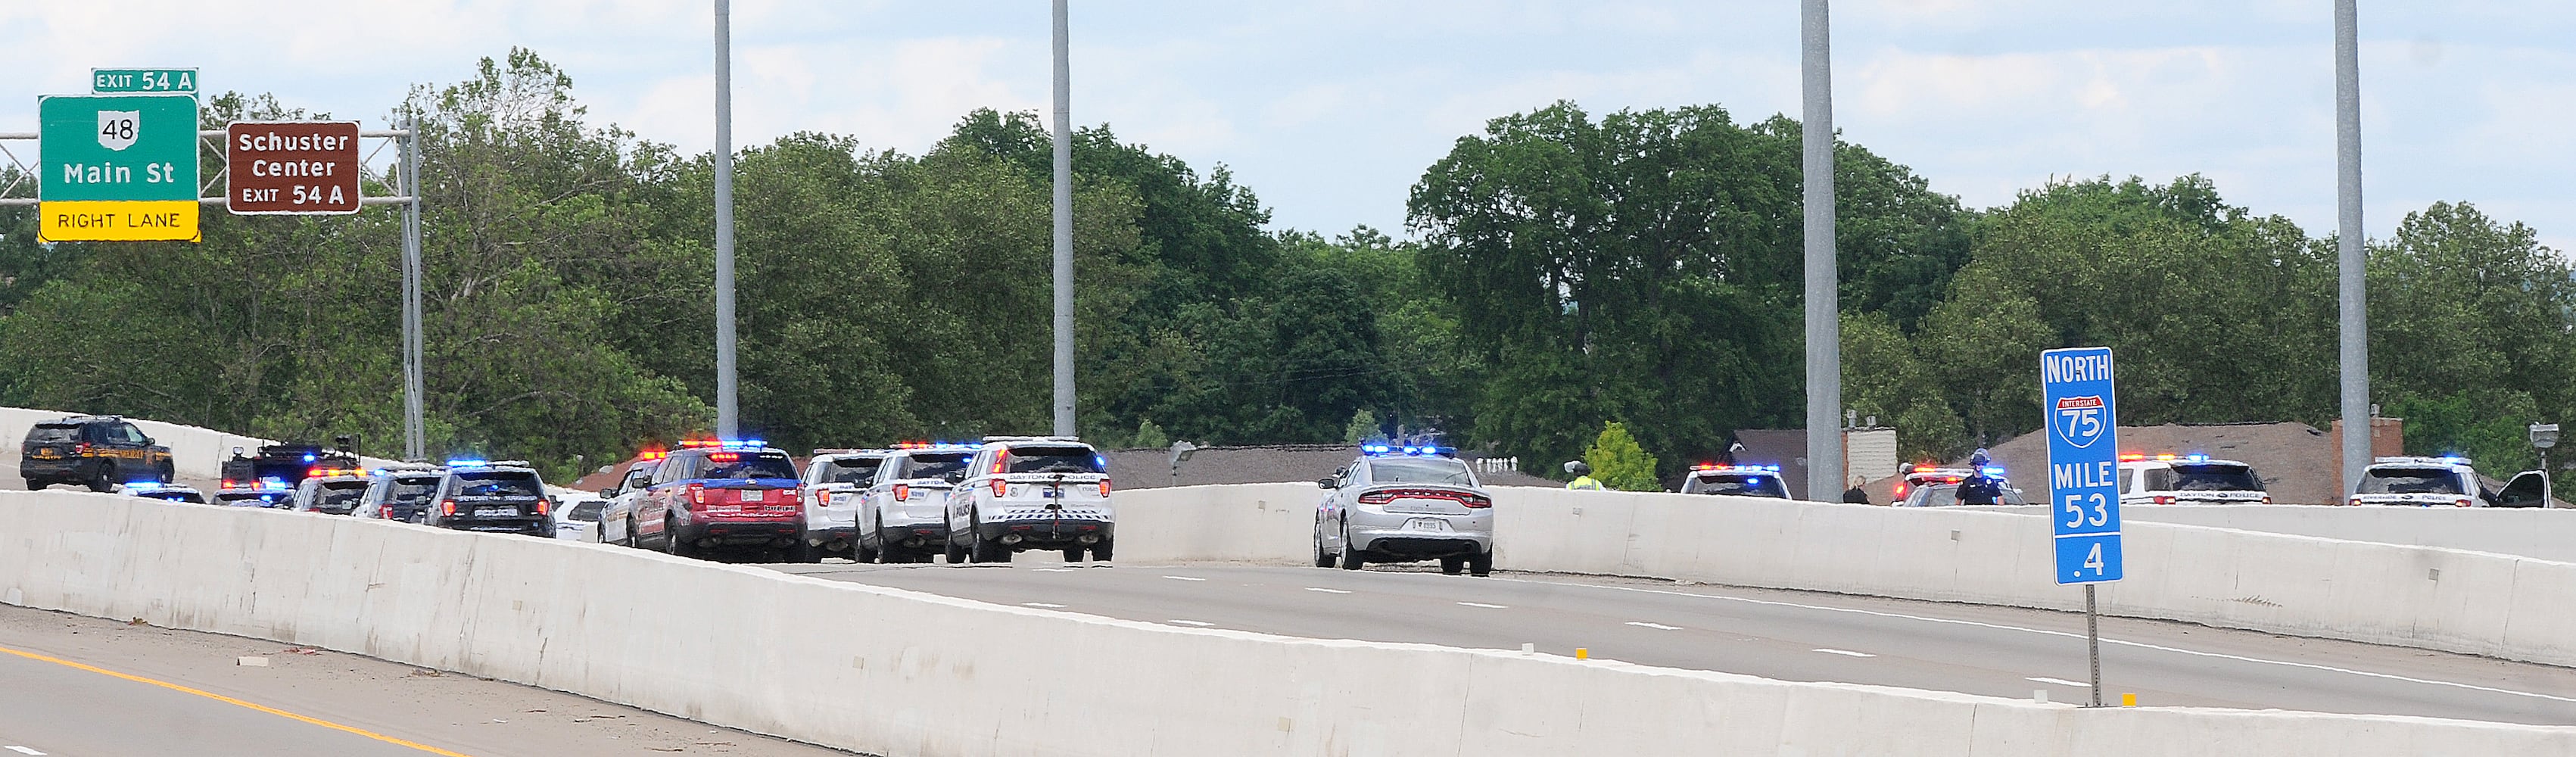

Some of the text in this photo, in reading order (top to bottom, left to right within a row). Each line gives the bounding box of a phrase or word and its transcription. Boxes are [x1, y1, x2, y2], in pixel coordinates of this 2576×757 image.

[96, 72, 193, 90] EXIT 54 A
[102, 120, 133, 139] 48
[239, 132, 349, 151] Schuster
[64, 162, 174, 183] Main St
[252, 160, 336, 176] Center
[243, 185, 344, 204] EXIT 54 A
[58, 213, 180, 228] RIGHT LANE
[2047, 354, 2108, 383] NORTH
[2062, 398, 2098, 407] INTERSTATE
[2062, 410, 2100, 437] 75
[2054, 461, 2113, 490] MILE
[2065, 493, 2107, 528] 53
